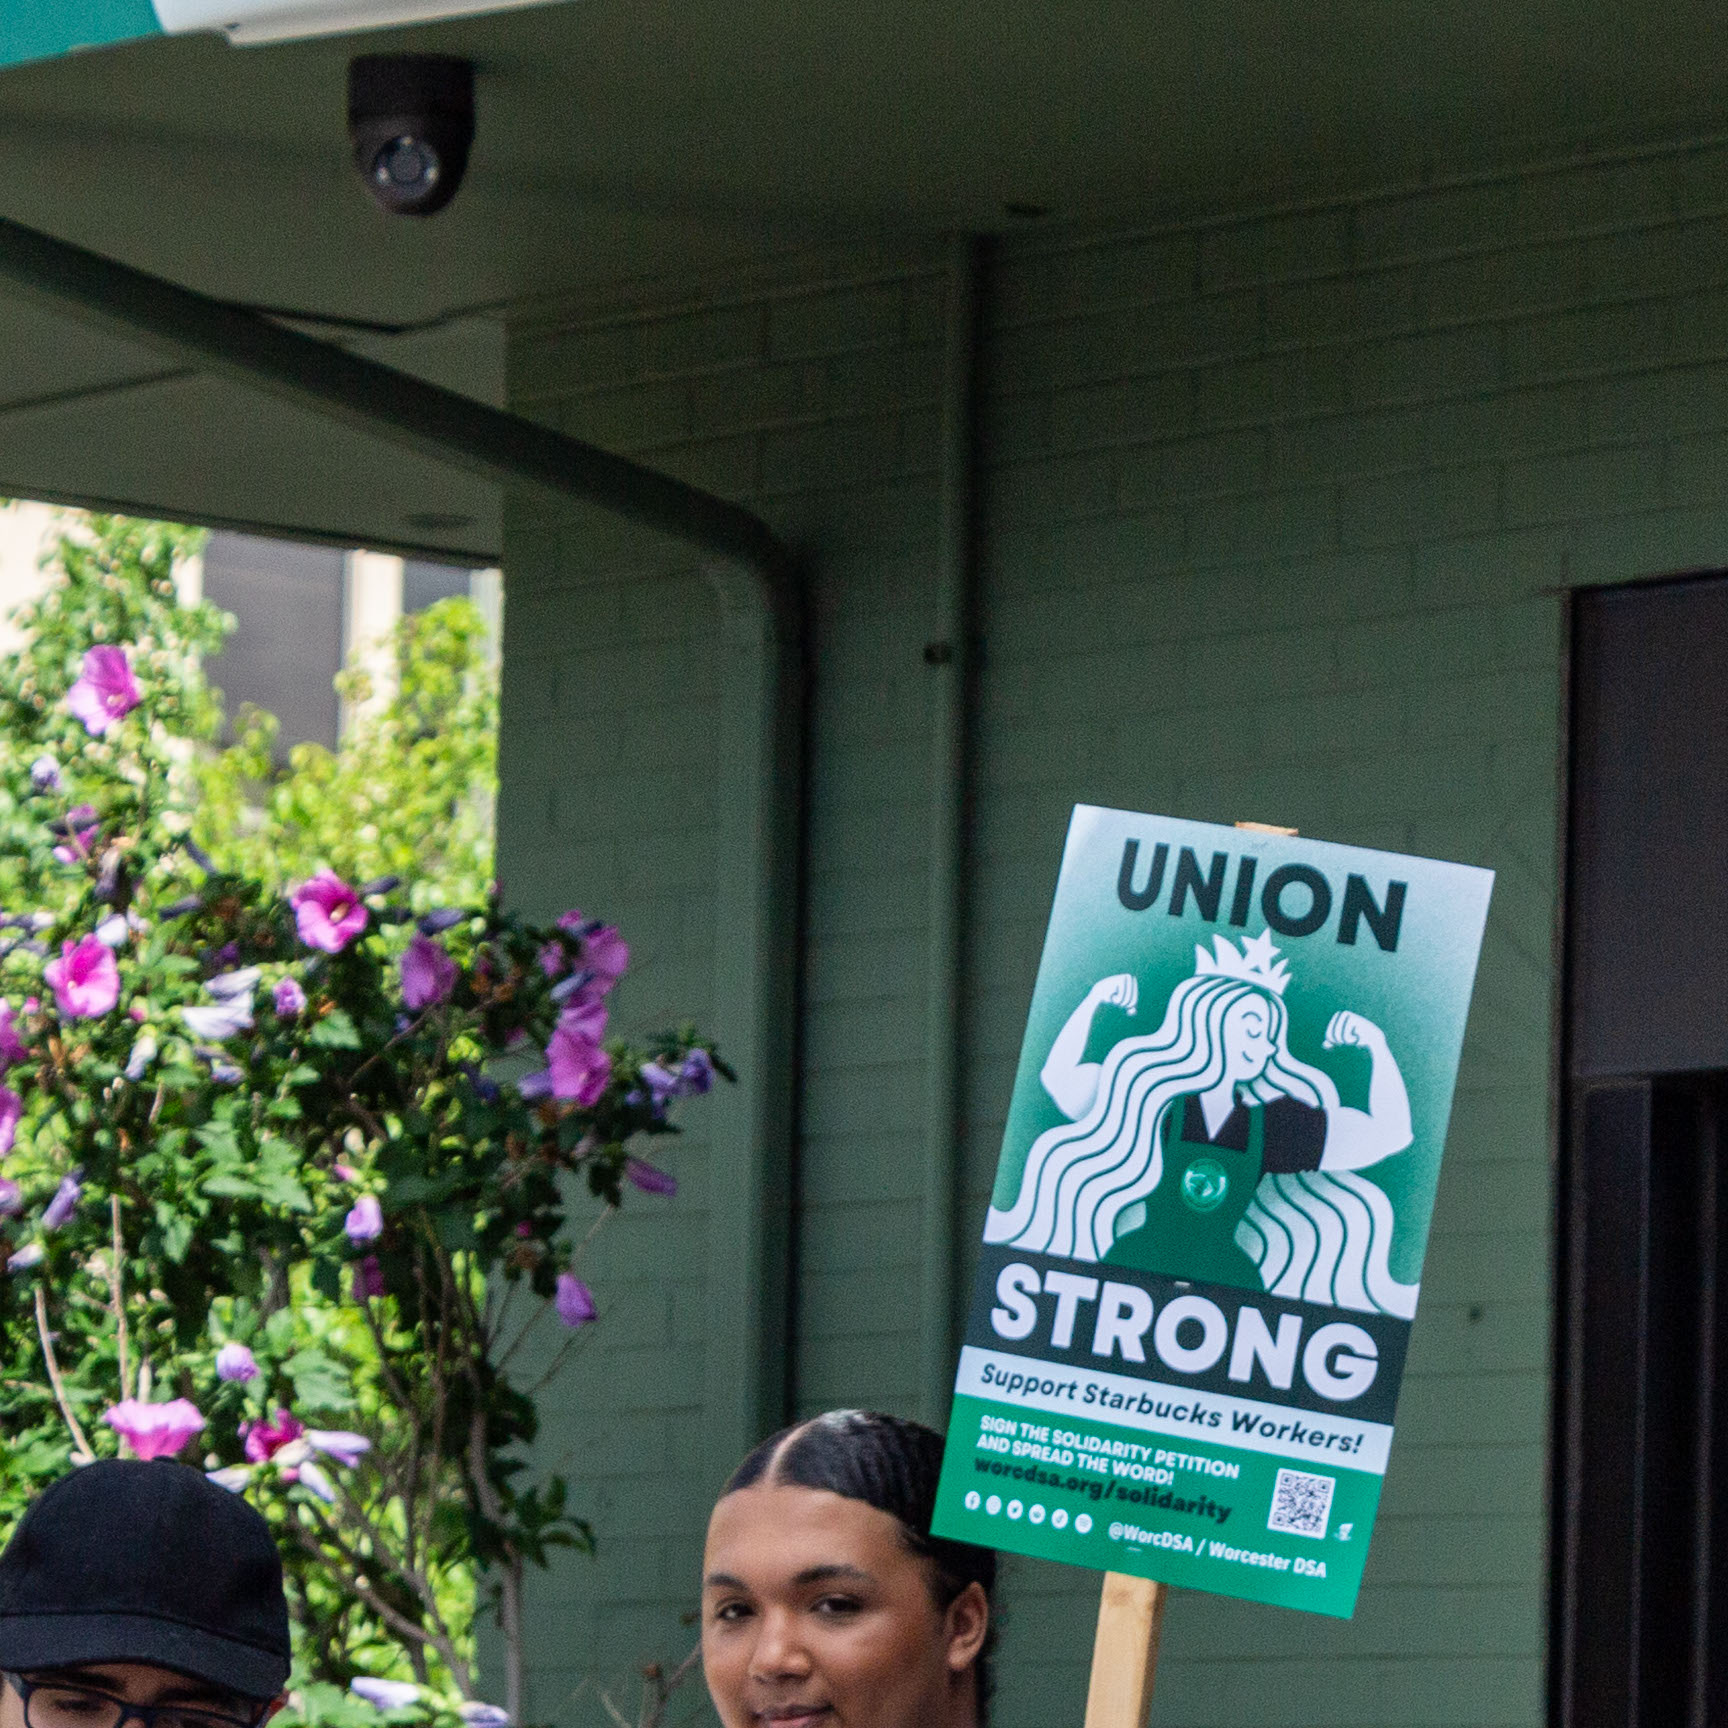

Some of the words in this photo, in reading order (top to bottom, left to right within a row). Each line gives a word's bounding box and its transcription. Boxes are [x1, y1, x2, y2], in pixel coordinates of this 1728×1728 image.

[1117, 838, 1408, 953] UNION
[990, 1262, 1379, 1400] STRONG
[981, 1363, 1078, 1401] Support
[1083, 1383, 1222, 1428] Starbucks
[1232, 1409, 1364, 1454] Workers!
[976, 1434, 1010, 1453] AND
[1012, 1441, 1074, 1466] SPREAD
[1077, 1453, 1109, 1474] THE
[1112, 1459, 1174, 1486] WORD!
[980, 1415, 1017, 1436] SIGN
[1020, 1422, 1050, 1443] THE
[1052, 1430, 1152, 1462] SOLIDARITY
[1154, 1449, 1240, 1479] PETITION
[975, 1457, 1232, 1524] worcdsa.org/solidarity
[1108, 1521, 1193, 1552] @WorcDSA
[1208, 1541, 1291, 1571] Worcester
[1293, 1557, 1326, 1578] DSA
